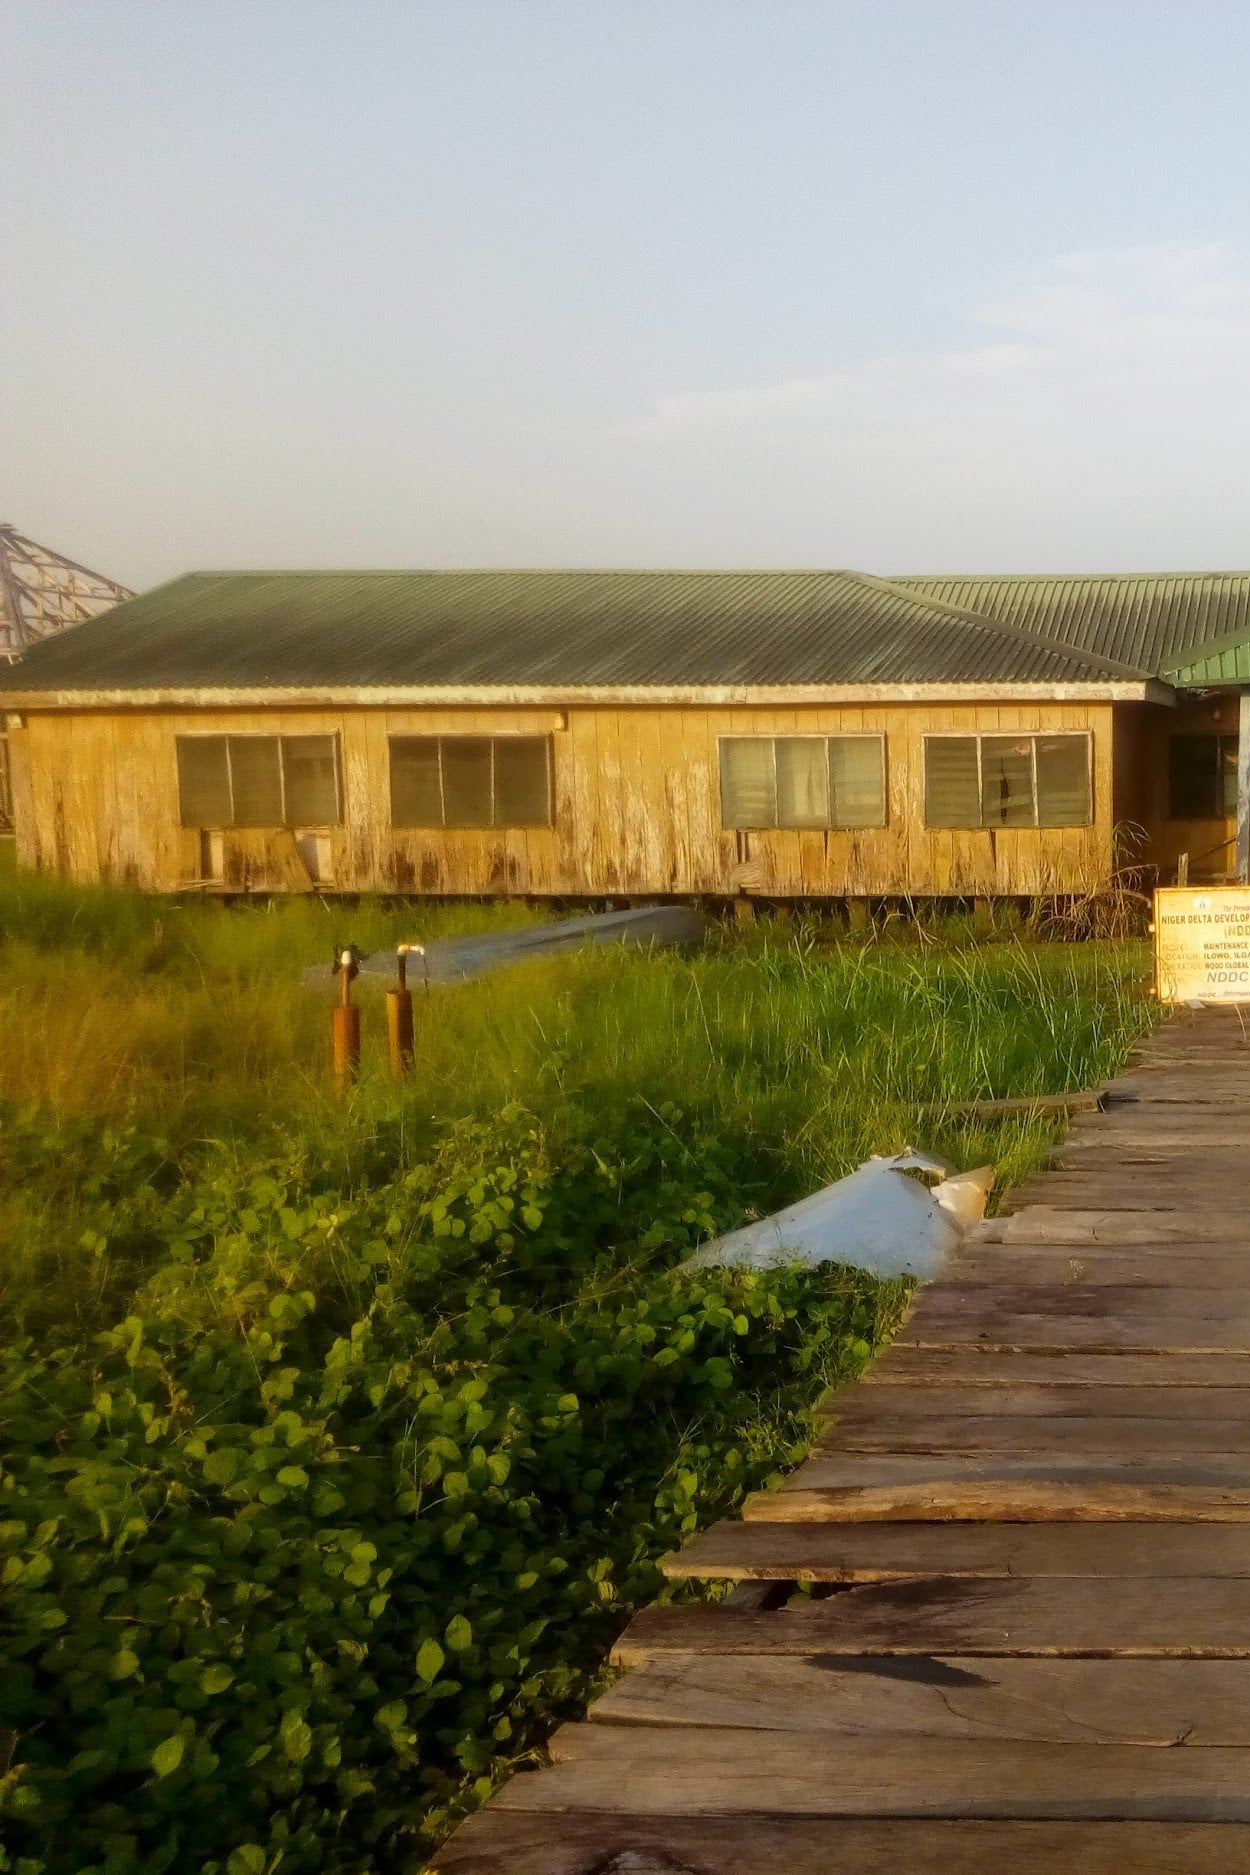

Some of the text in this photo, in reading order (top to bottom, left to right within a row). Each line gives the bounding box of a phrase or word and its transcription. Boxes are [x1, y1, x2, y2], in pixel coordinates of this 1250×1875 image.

[1161, 915, 1186, 925] NIGER
[1188, 914, 1212, 924] DELTA
[1203, 941, 1248, 950] MAINTENANCE
[1225, 960, 1250, 969] GLOBAL
[1206, 971, 1249, 983] NDDC
